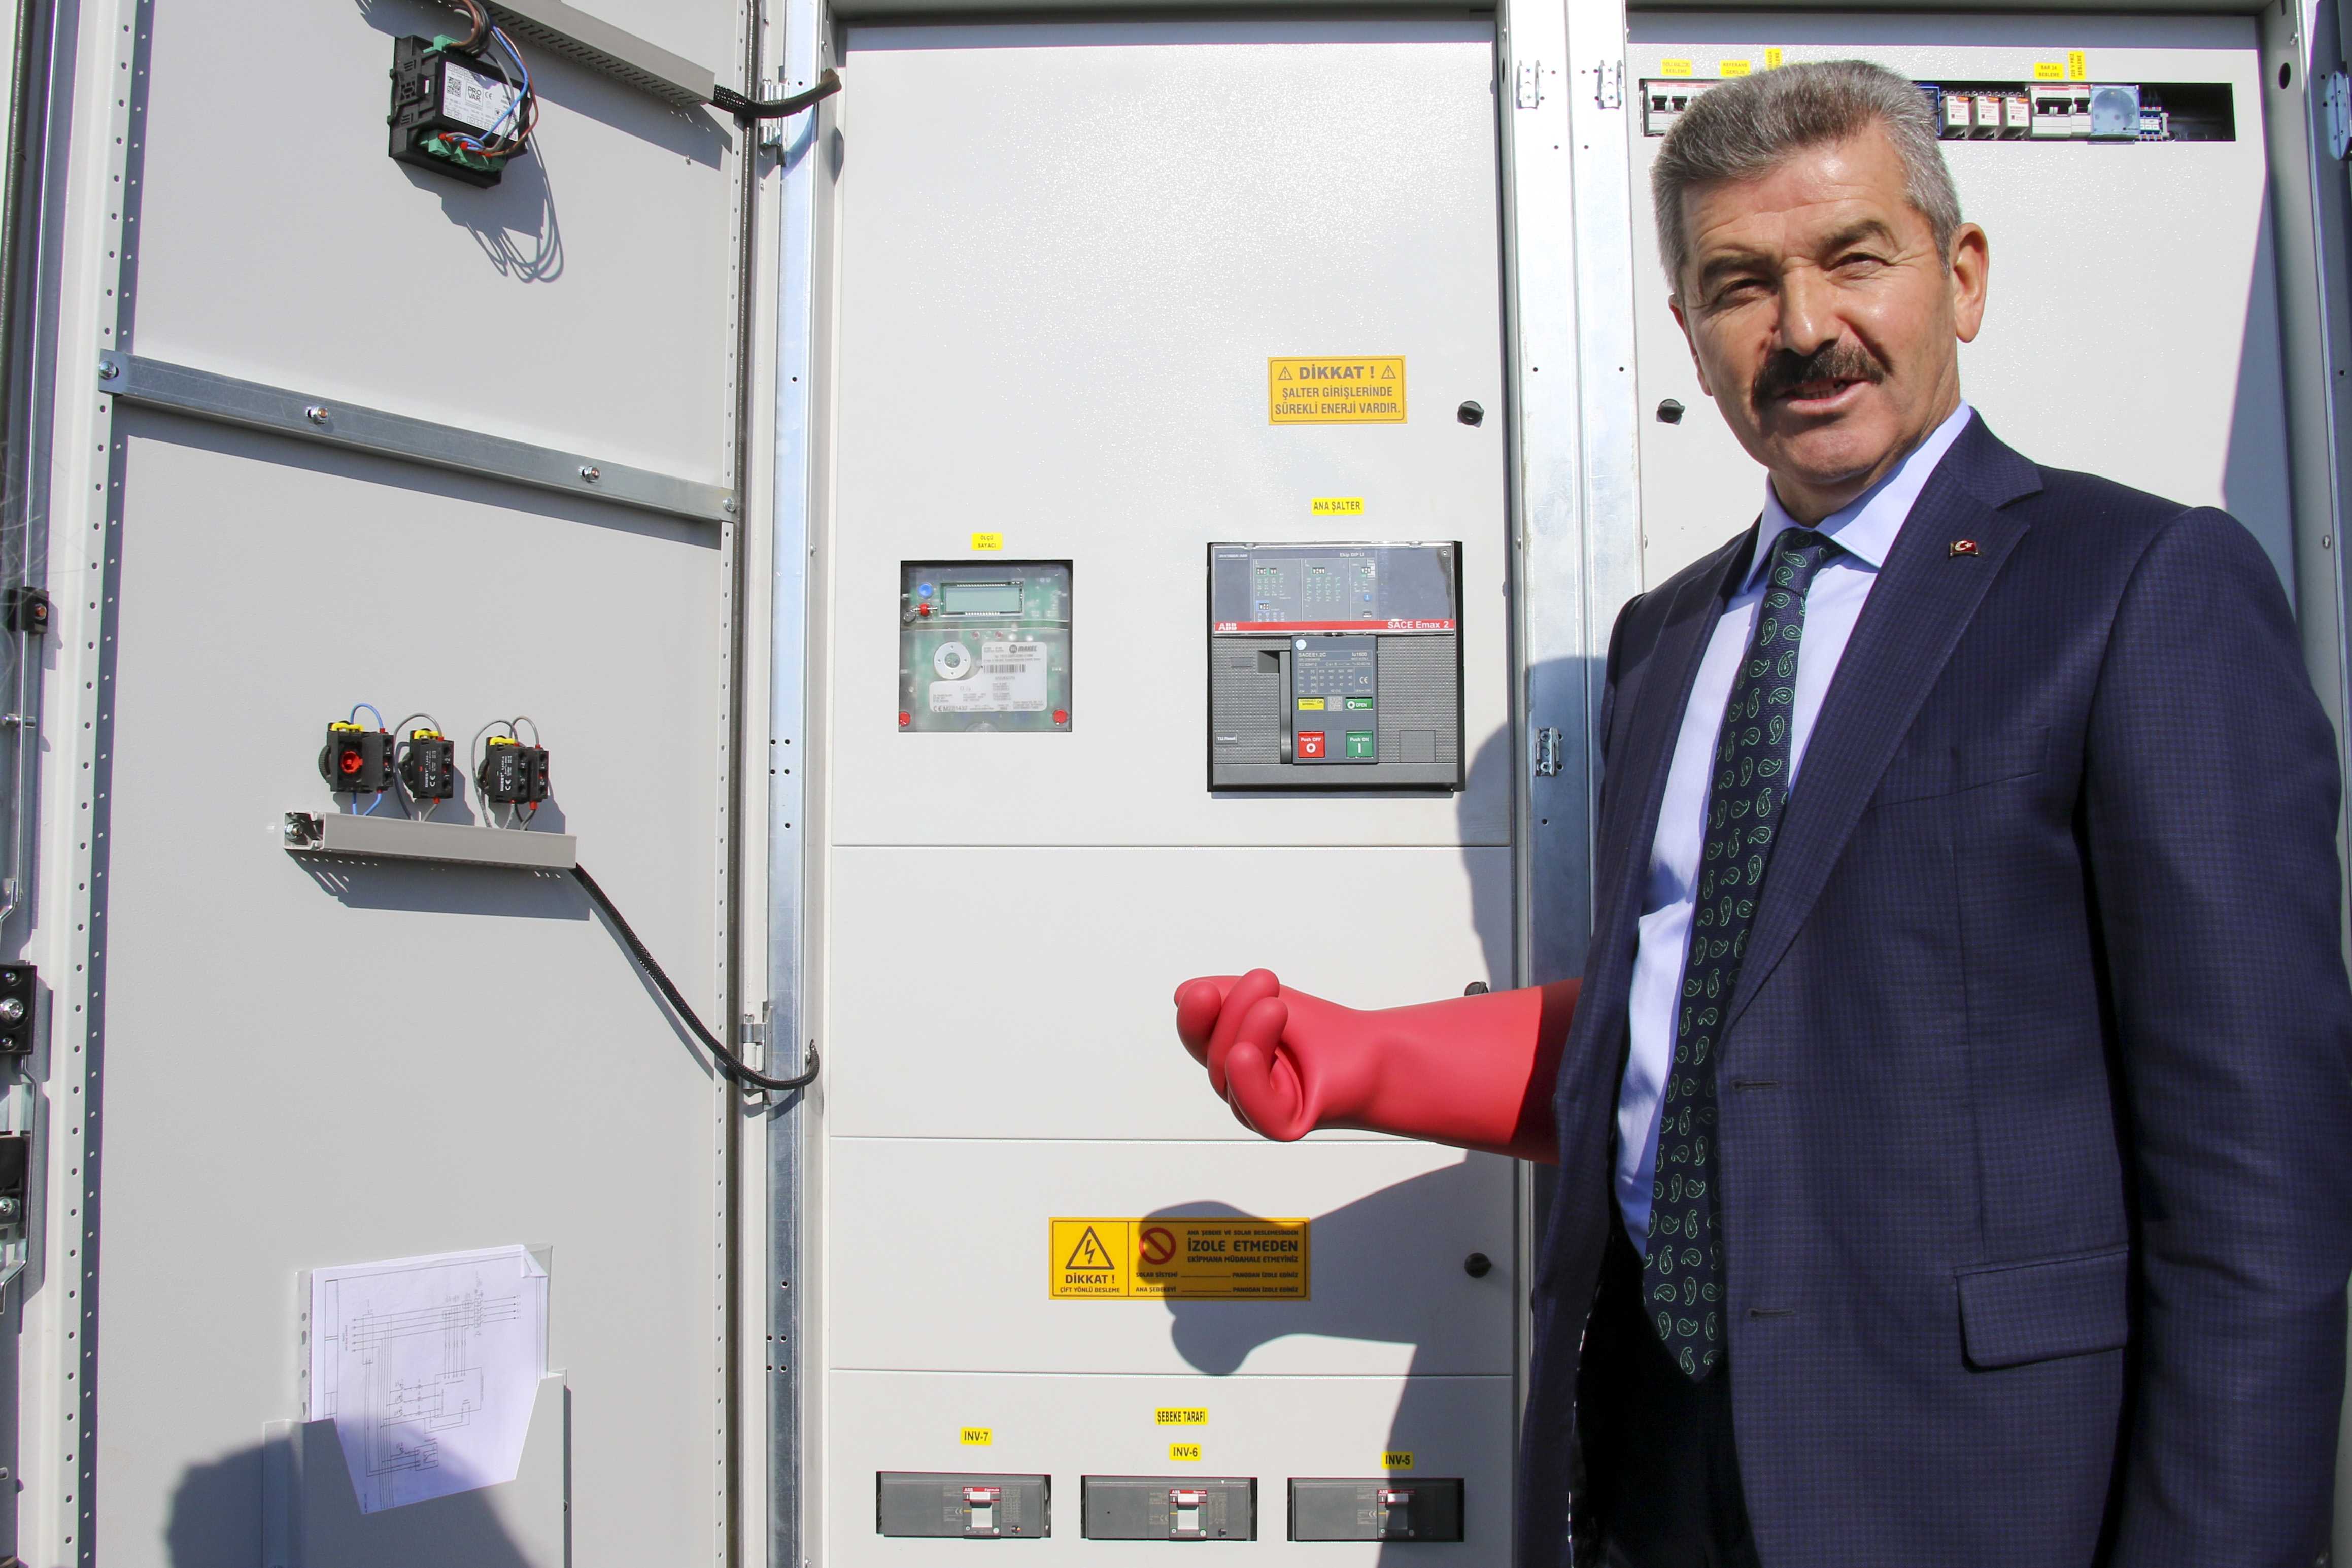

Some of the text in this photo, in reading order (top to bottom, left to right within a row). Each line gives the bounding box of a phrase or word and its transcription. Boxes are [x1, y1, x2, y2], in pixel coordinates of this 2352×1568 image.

[468, 86, 482, 96] PRO
[468, 94, 481, 102] VAR
[1299, 364, 1364, 379] DİKKAT
[1282, 385, 1392, 400] ŞALTER GİRİŞLERİNDE
[1275, 401, 1401, 414] SÜREKLİ ENERJİ VARDIR.
[1313, 501, 1360, 512] ANA ŞALTER
[1218, 622, 1237, 630] ABB
[1188, 1238, 1298, 1252] İZOLE ETMEDEN
[1065, 1272, 1108, 1284] DİKKAT
[1157, 1411, 1205, 1424] ŞEBEKE TARAFI
[964, 1430, 988, 1441] INV-7
[1173, 1447, 1198, 1457] INV-6
[1385, 1455, 1410, 1465] INV-5
